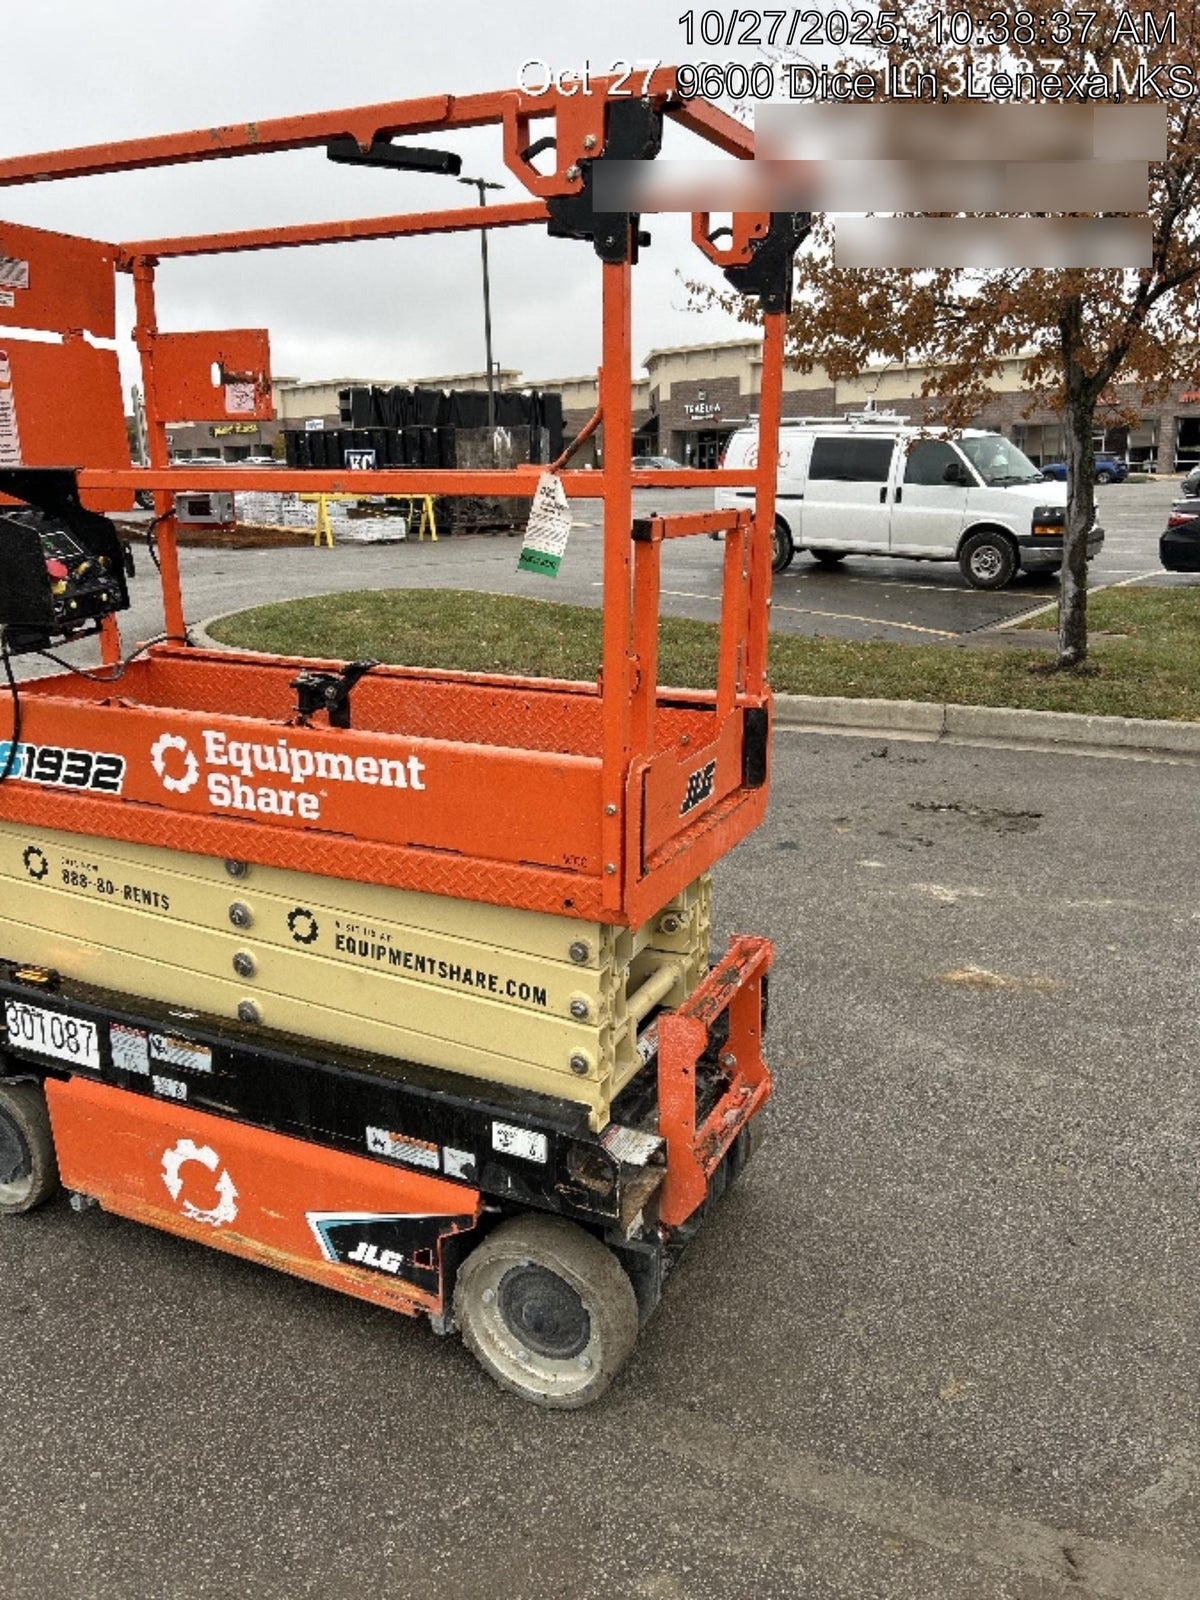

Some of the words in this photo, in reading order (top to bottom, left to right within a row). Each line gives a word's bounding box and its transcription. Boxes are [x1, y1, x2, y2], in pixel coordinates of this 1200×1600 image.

[202, 729, 426, 790] Equipment
[207, 772, 320, 820] Share
[61, 868, 169, 911] 888-80-RENTS
[335, 933, 547, 1006] EQUIPMENTSHARE.COM
[348, 1242, 404, 1274] JLG
